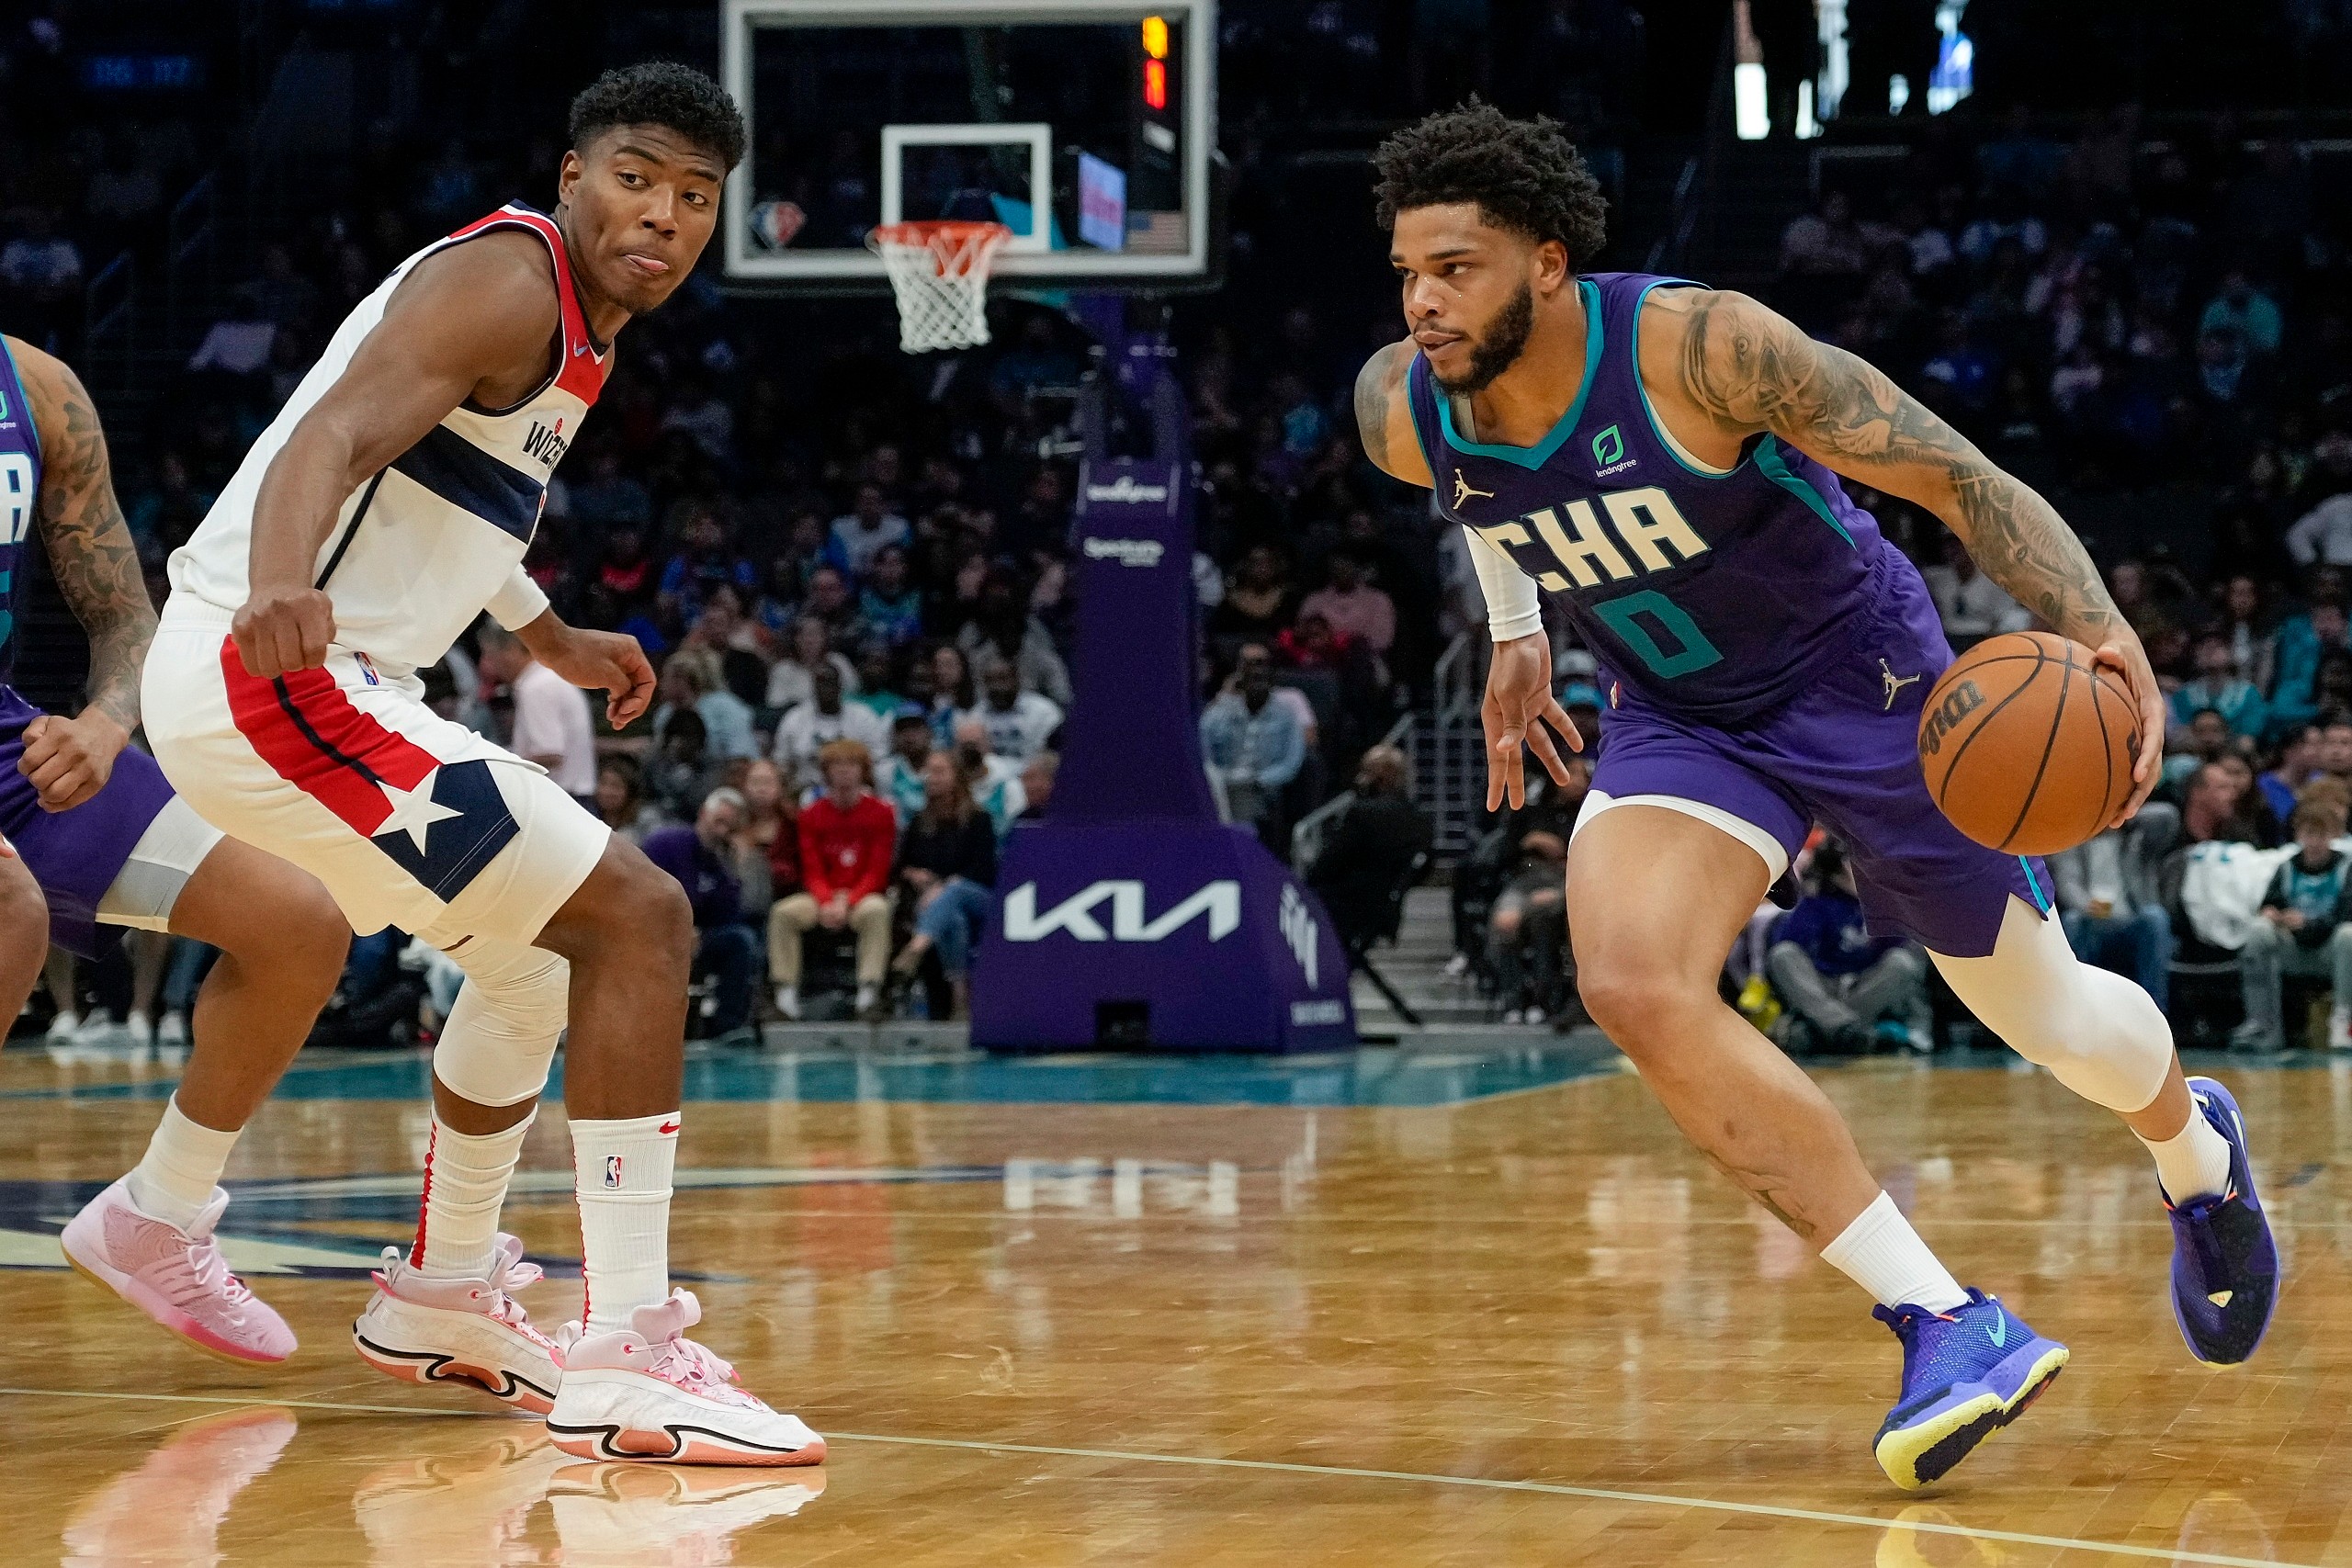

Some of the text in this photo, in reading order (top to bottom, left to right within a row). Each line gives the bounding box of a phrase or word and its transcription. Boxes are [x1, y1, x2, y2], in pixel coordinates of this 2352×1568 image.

[1595, 459, 1637, 478] lendingtree
[1472, 485, 1713, 592] CHA
[1590, 589, 1724, 679] 0
[1003, 879, 1241, 942] KIA
